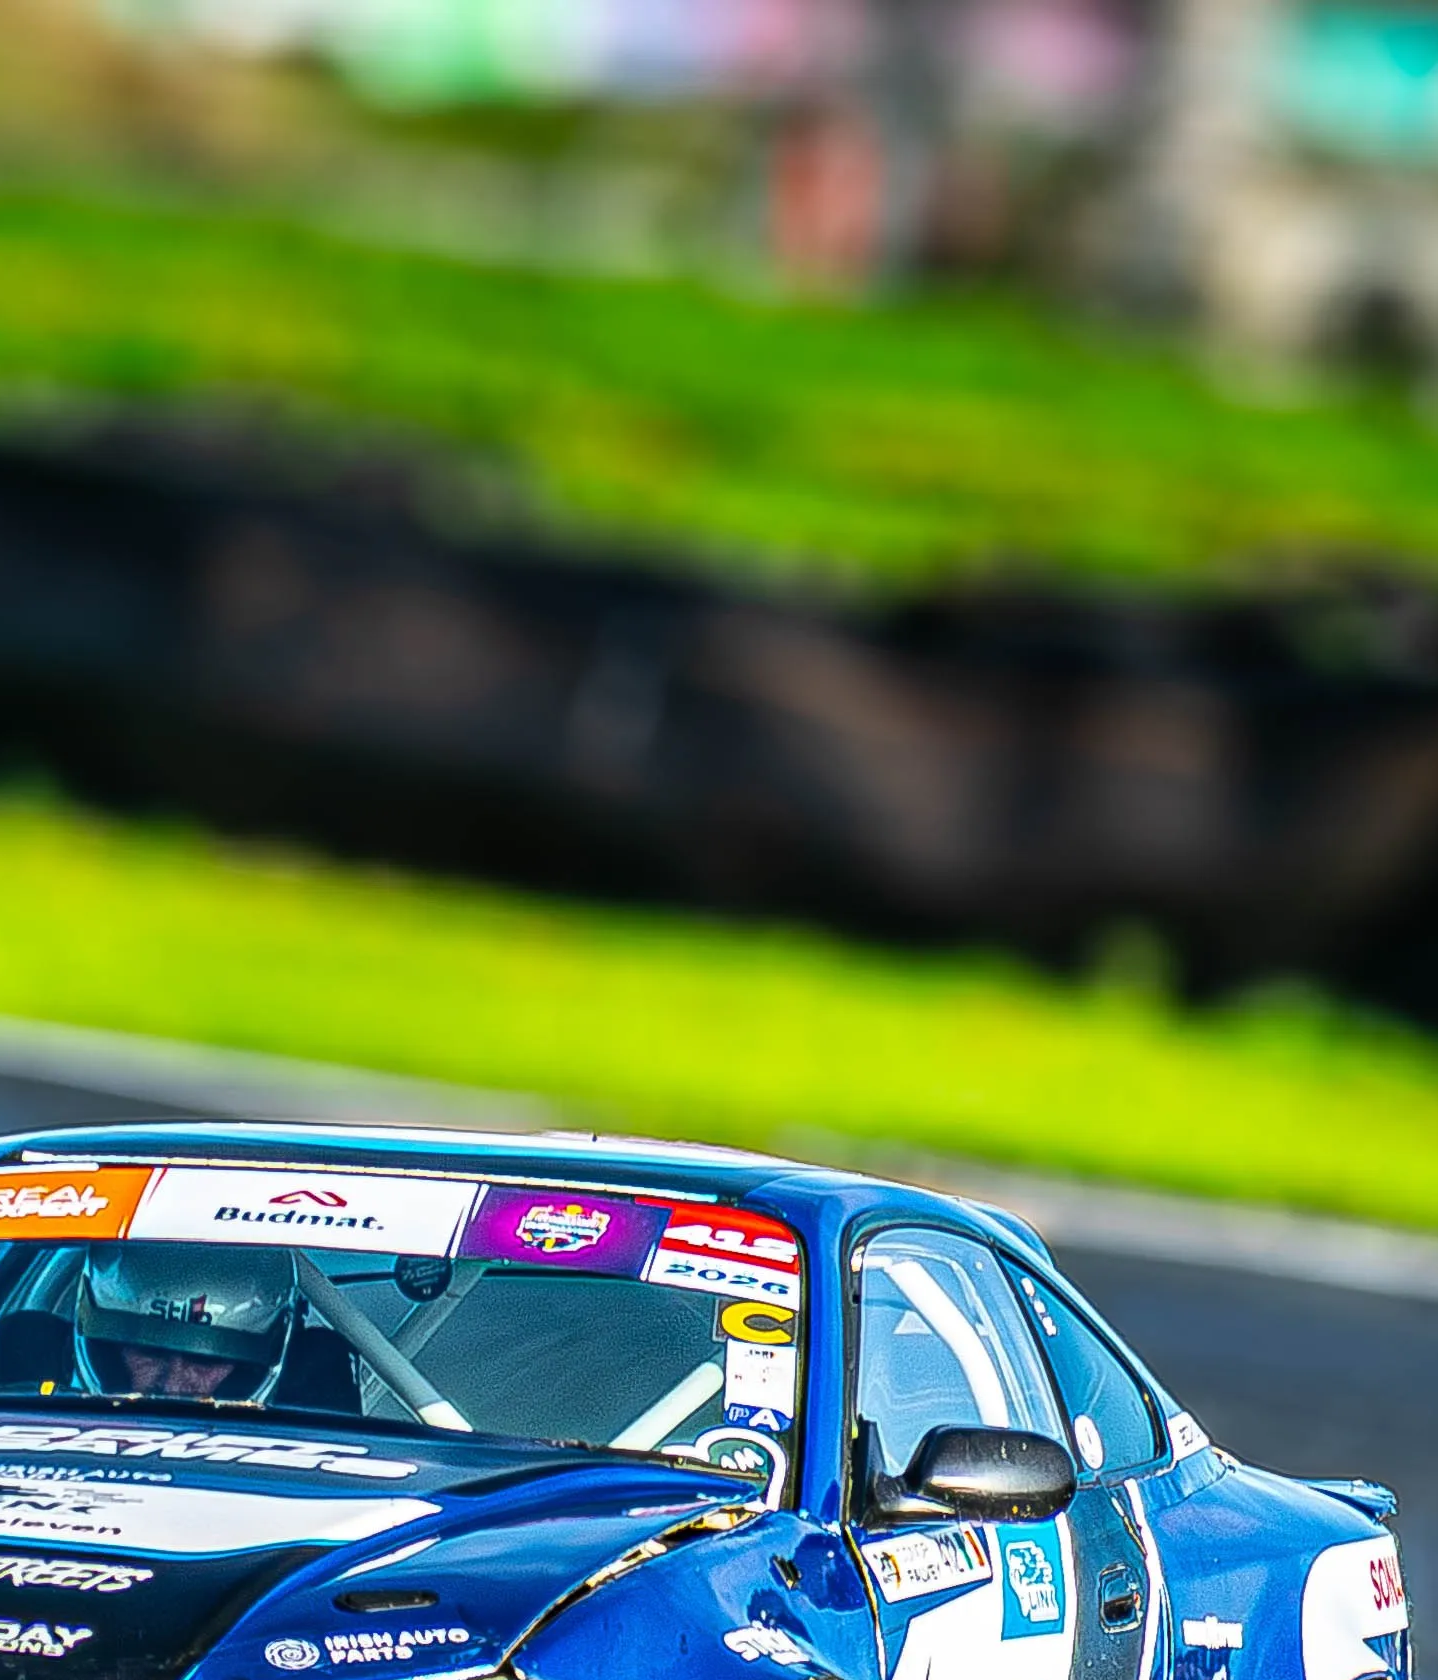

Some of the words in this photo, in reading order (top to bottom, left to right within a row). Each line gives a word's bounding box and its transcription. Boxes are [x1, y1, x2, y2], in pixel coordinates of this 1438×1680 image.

[214, 1206, 385, 1231] Budmat.
[664, 1263, 791, 1294] 2026
[721, 1301, 795, 1344] C
[324, 1632, 394, 1651] IRISH
[398, 1628, 470, 1646] AUTO
[330, 1645, 414, 1664] PARTS
